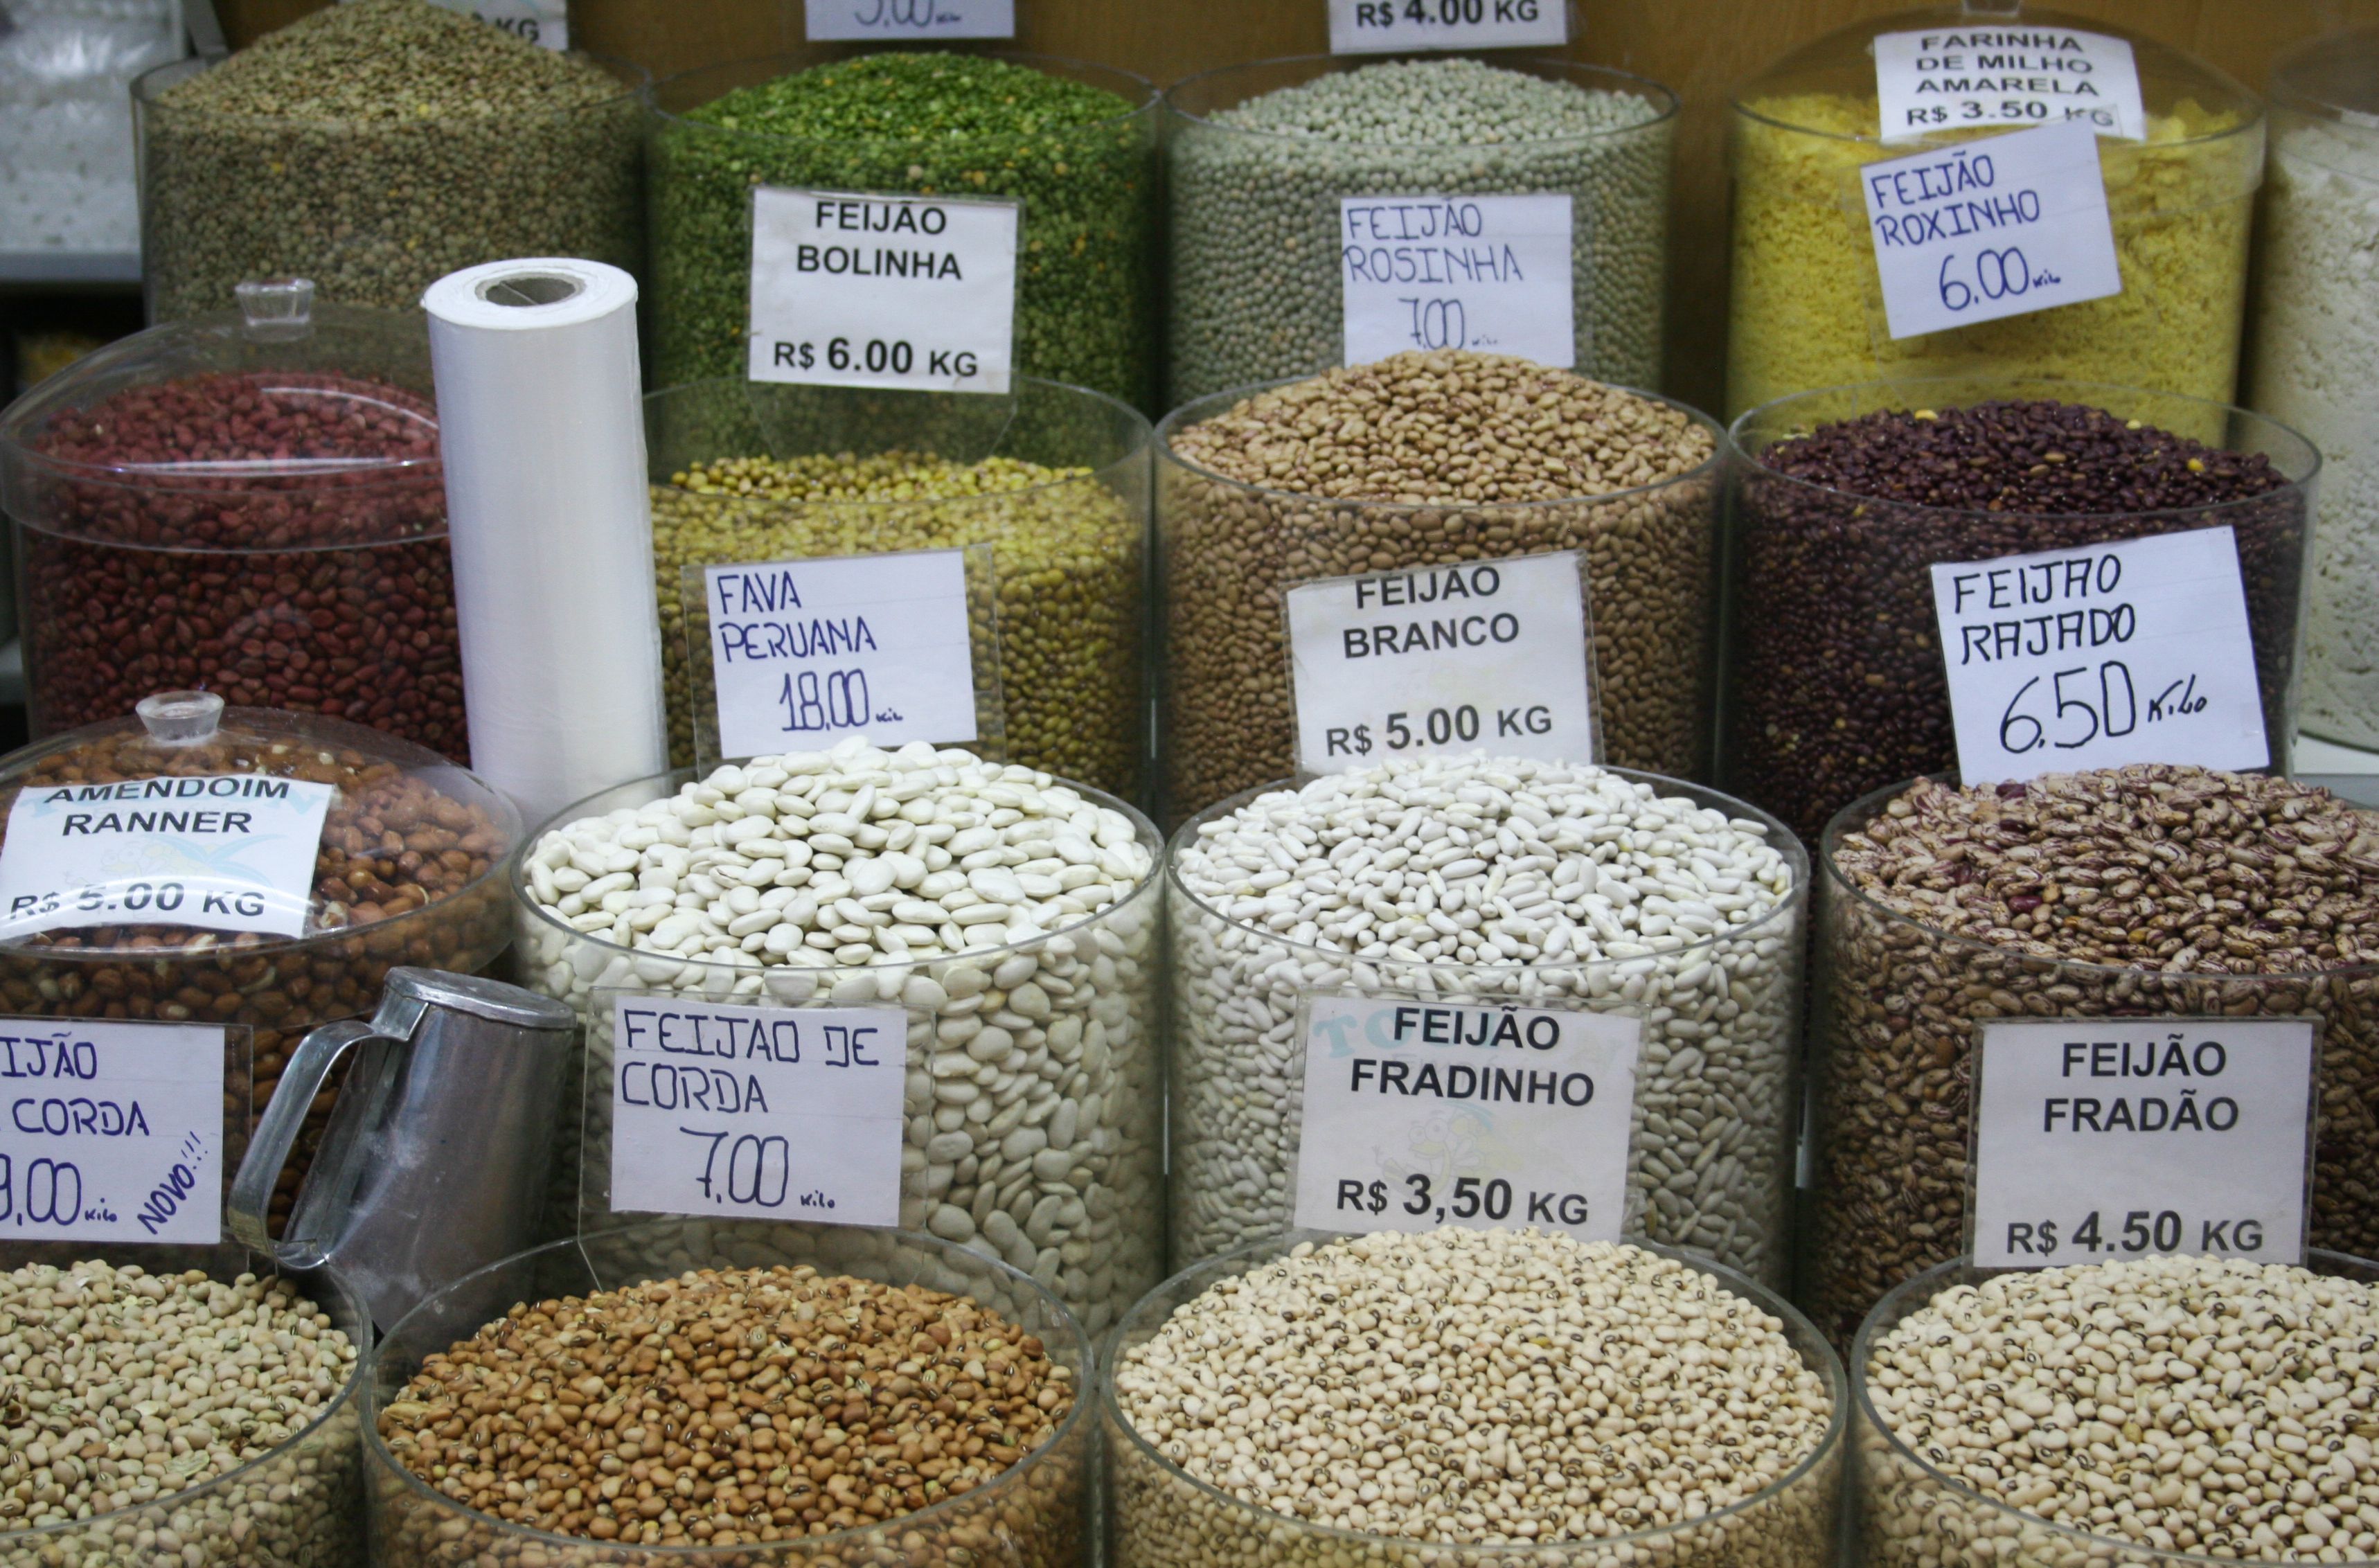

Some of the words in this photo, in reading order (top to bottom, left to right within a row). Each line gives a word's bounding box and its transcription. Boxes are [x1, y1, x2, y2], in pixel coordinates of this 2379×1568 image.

[1356, 3, 1394, 28] R$
[1404, 0, 1483, 25] 4.00
[1495, 0, 1539, 22] KG
[1916, 55, 1964, 71] DE
[1977, 55, 2093, 73] MILHO
[1921, 33, 2083, 51] FARINHA
[1915, 78, 2100, 96] AMARELA
[1907, 106, 1948, 126] R$
[1961, 101, 2048, 119] 3.50
[1871, 150, 1994, 208] FEIJÃO
[816, 201, 946, 235] FEIJÃO
[1875, 189, 2040, 247] ROXINHO
[796, 244, 962, 280] BOLINHA
[1343, 244, 1524, 283] ROSINHA
[774, 341, 815, 370] R$
[828, 337, 914, 375] 6.00
[929, 350, 978, 377] KG
[718, 570, 801, 614] FAVA
[1953, 553, 2122, 614] FEIJAO
[718, 615, 877, 663] PERUANA
[1343, 612, 1520, 659] BRANCO
[1961, 603, 2136, 665] RAJADO
[1326, 724, 1373, 756] R$
[1386, 704, 1480, 750] 5.00
[1497, 705, 1552, 737] KG
[43, 778, 290, 803] AMENDOIM
[62, 811, 253, 836] RANNER
[9, 891, 61, 920] R$
[76, 882, 186, 911] 5.00
[203, 891, 266, 917] KG
[624, 1008, 801, 1063] FEIJAO
[823, 1026, 880, 1067] DE
[1393, 1005, 1560, 1051] FEIJÃO
[2061, 1033, 2227, 1078] FEIJÃO
[622, 1062, 769, 1114] CORDA
[1351, 1058, 1594, 1107] FRADINHO
[12, 1098, 150, 1136] CORDA
[2043, 1089, 2239, 1132] FRADÃO
[1336, 1179, 1389, 1215] R$
[1402, 1173, 1513, 1224] 3,50
[1527, 1192, 1588, 1225] KG
[2006, 1220, 2058, 1257] R$
[2071, 1210, 2182, 1253] 4.50
[2202, 1220, 2263, 1251] KG
